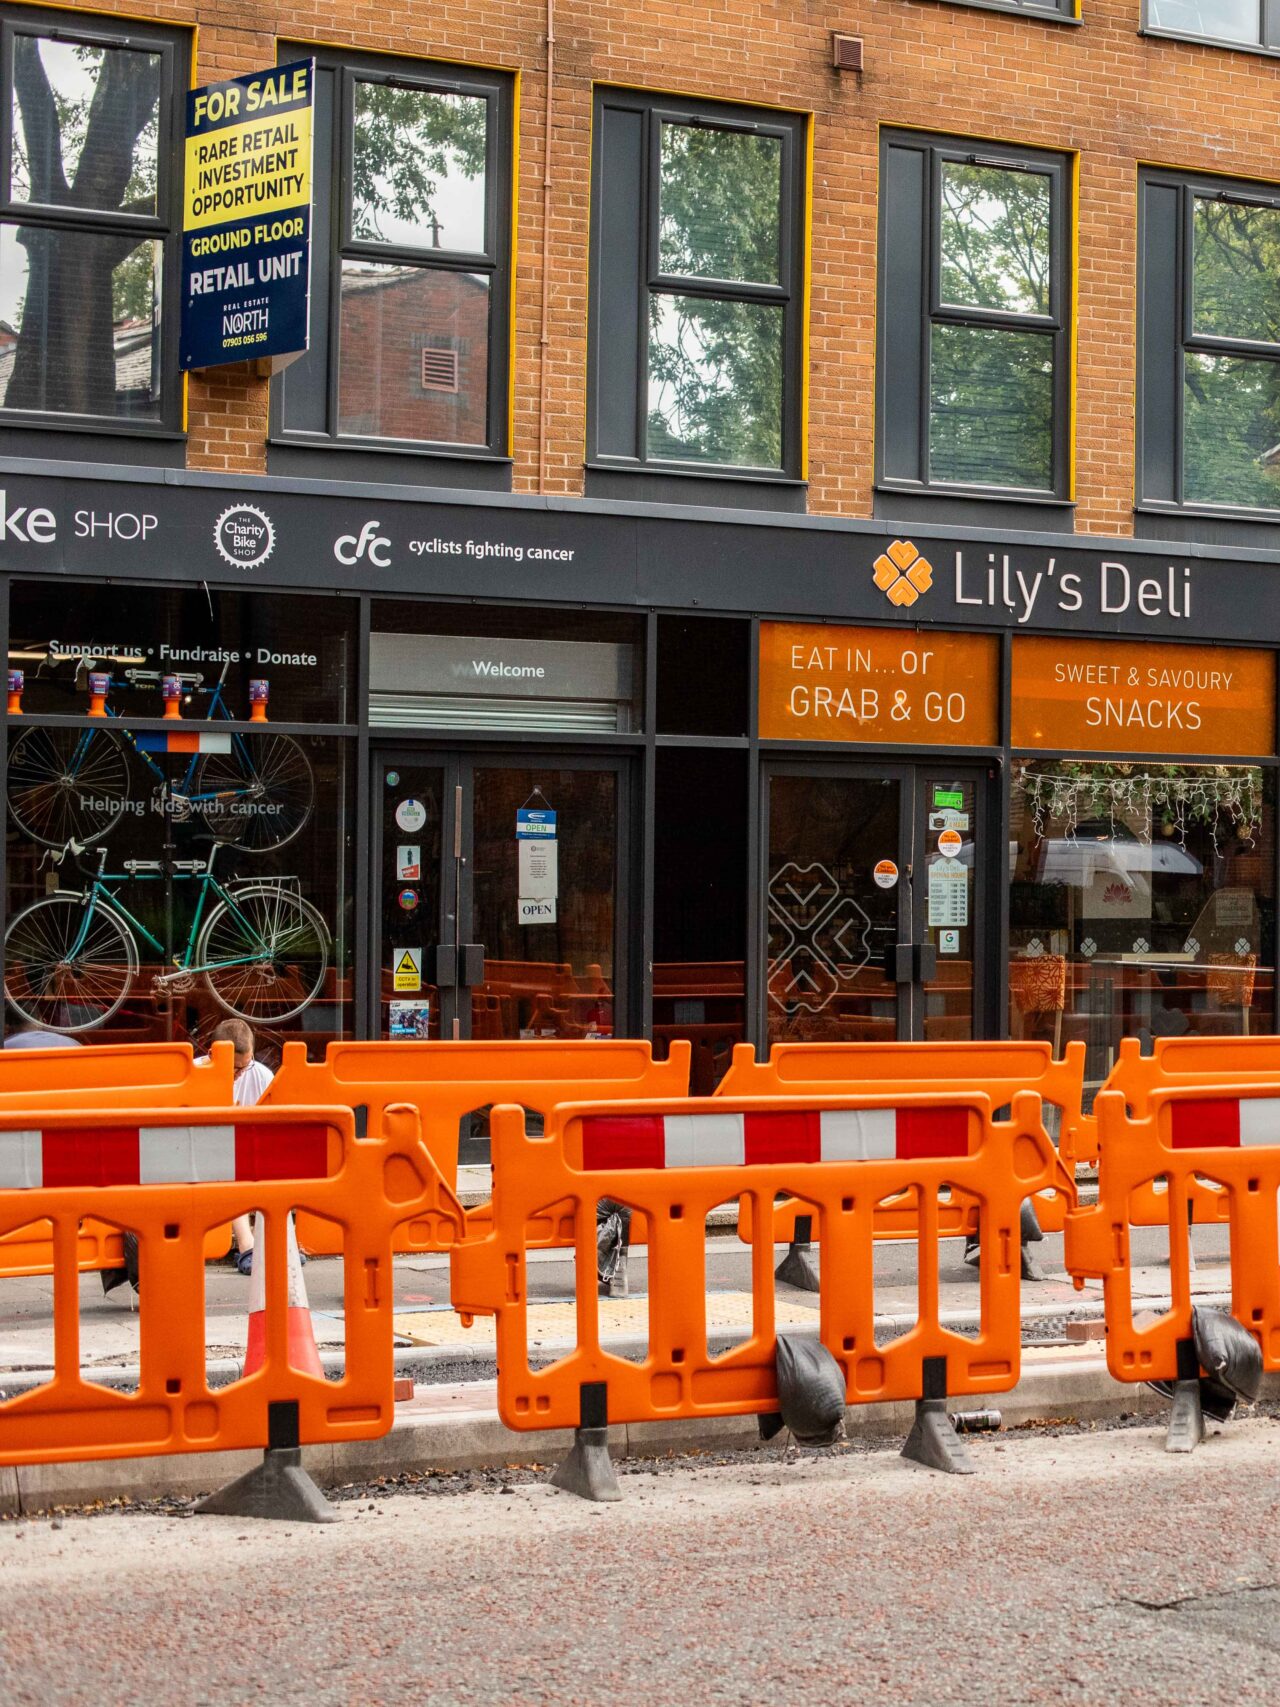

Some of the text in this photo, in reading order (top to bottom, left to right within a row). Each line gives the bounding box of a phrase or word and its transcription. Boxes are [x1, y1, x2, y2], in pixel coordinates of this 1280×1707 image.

[194, 68, 307, 127] FOR SALE
[199, 123, 299, 165] RARE RETAIL
[198, 149, 297, 191] INVESTMENT
[192, 173, 305, 217] OPPORTUNITY
[191, 217, 304, 257] GROUND FLOOR
[190, 251, 303, 296] RETAIL UNIT
[223, 297, 269, 312] REAL ESTATE
[223, 308, 269, 336] NORTH
[222, 332, 268, 348] 07903 056 596
[74, 510, 158, 541] SHOP
[225, 522, 265, 539] Charity
[233, 535, 256, 547] Bike
[333, 520, 392, 568] cfc
[409, 538, 575, 562] cyclists fighting cancer
[955, 551, 1191, 624] Lily's Deli
[49, 639, 317, 666] Support us Fundraise Donate
[791, 645, 838, 671] EAT
[901, 650, 934, 675] or
[472, 660, 545, 678] Welcome
[1055, 663, 1233, 690] SWEET & SAVOURY
[790, 685, 966, 723] GRAB & GO
[1086, 696, 1202, 730] SNACKS
[80, 795, 284, 817] Helping kids with cancer
[522, 904, 552, 916] OPEN
